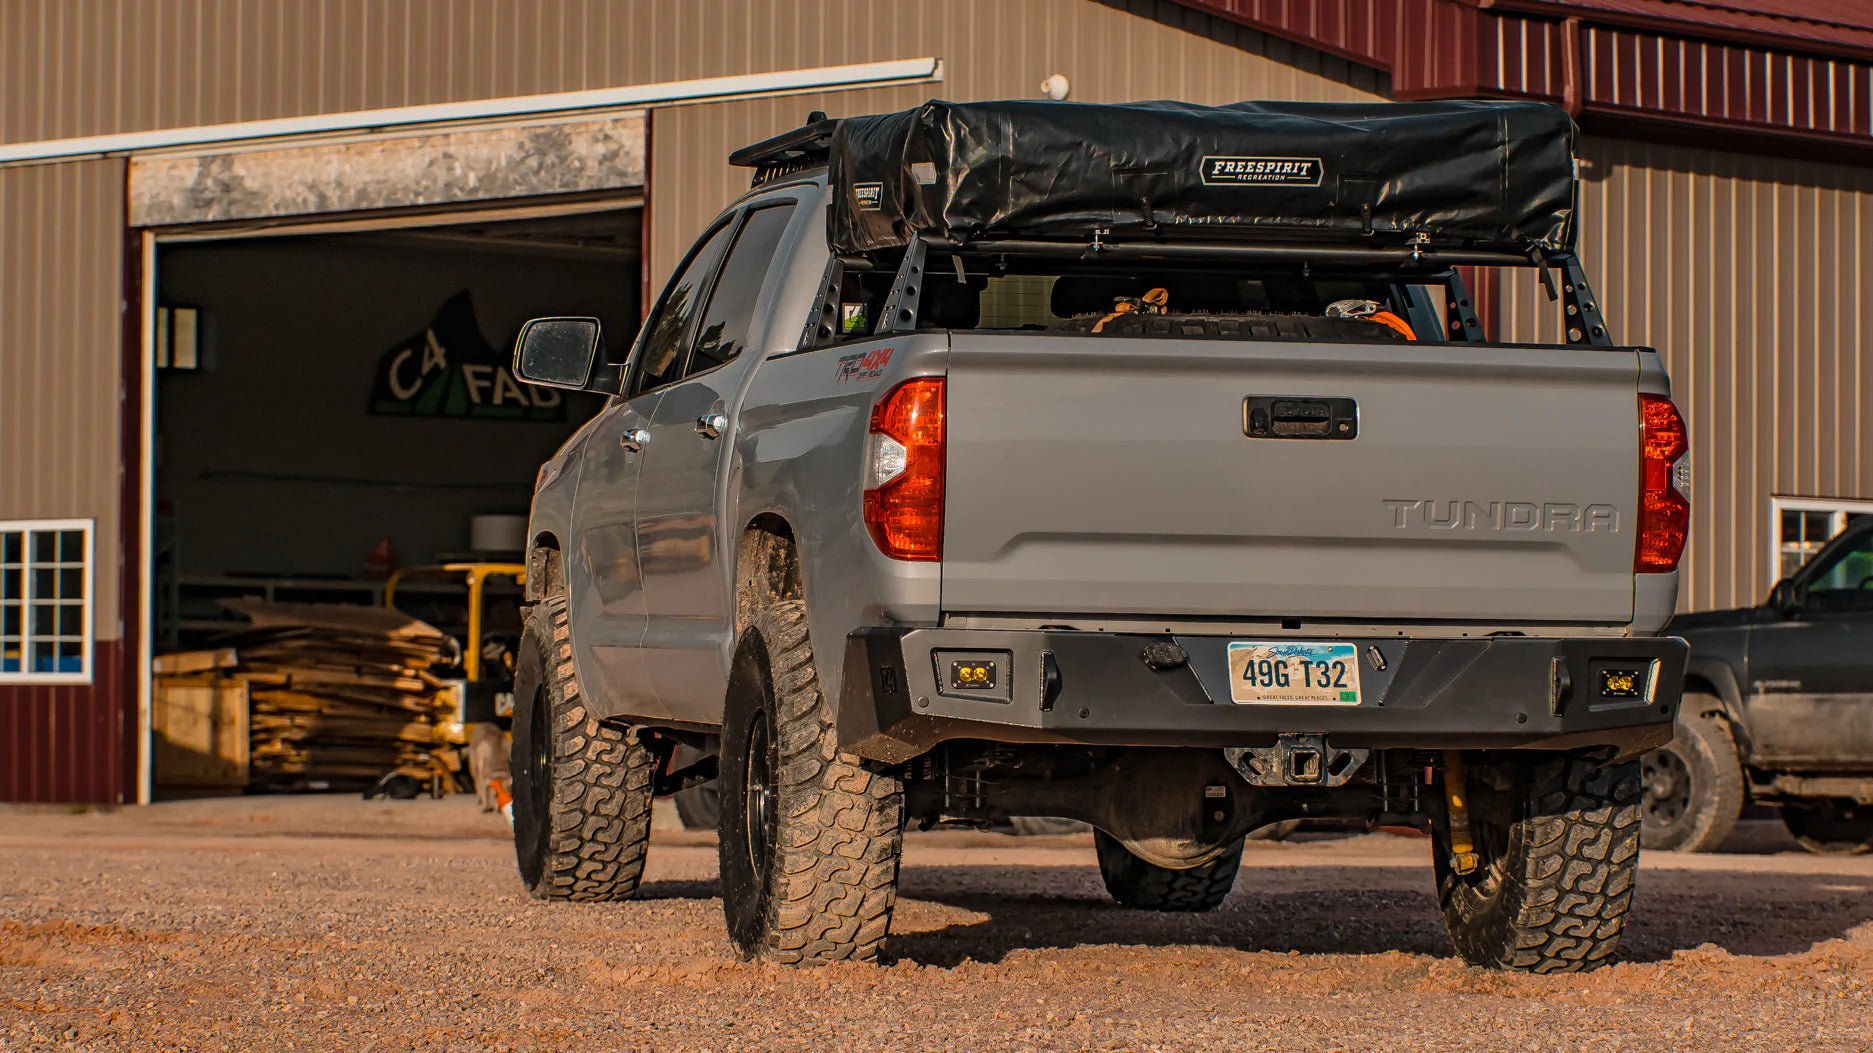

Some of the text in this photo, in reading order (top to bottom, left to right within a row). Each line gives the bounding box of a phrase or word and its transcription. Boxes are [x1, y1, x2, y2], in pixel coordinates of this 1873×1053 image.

[1211, 160, 1312, 176] FREESPIRIT
[1382, 499, 1620, 532] TUNDRA
[1242, 659, 1347, 689] 49G T32
